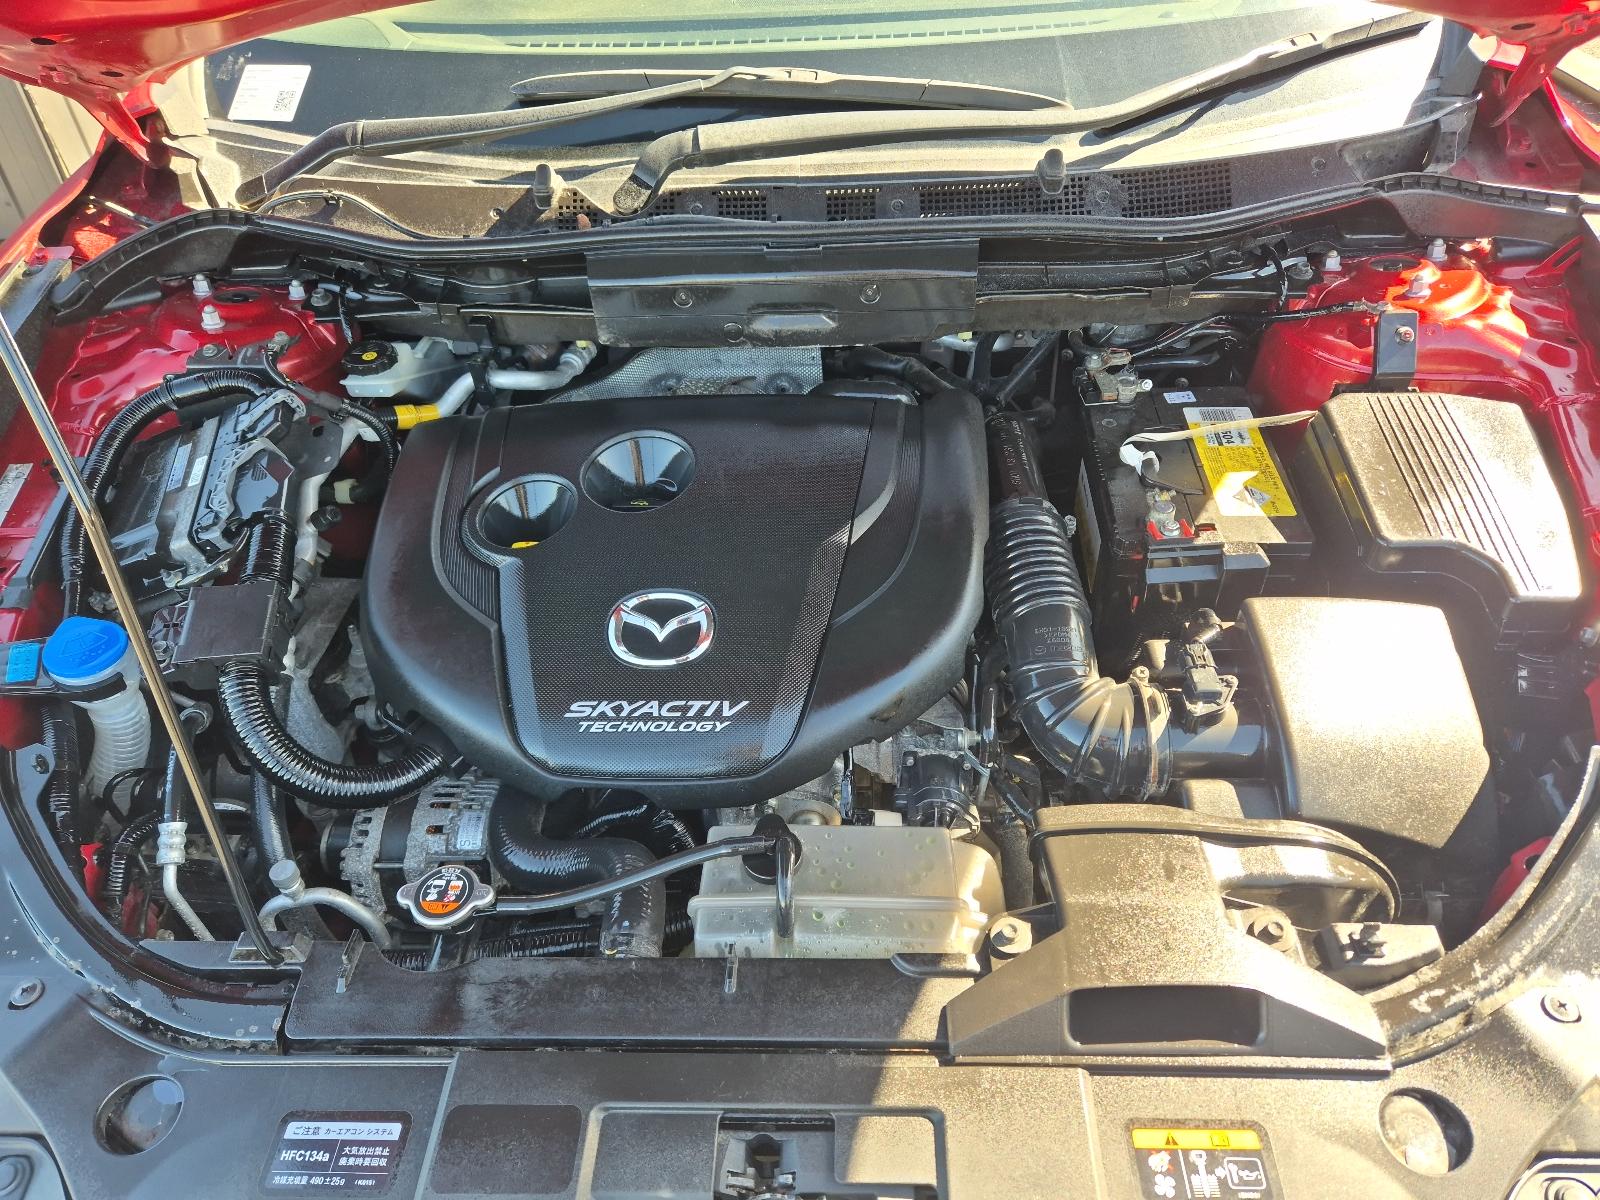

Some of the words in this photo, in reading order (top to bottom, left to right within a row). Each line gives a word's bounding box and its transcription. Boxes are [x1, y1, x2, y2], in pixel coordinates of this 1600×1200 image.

[563, 700, 751, 718] SKYACTIV
[578, 721, 731, 733] TECHNOLOGY
[293, 1126, 321, 1136] ご注意
[324, 1128, 365, 1136] カーエアコン
[366, 1128, 394, 1136] システム
[280, 1150, 330, 1162] HFC134a
[341, 1146, 390, 1156] 大気放出禁止
